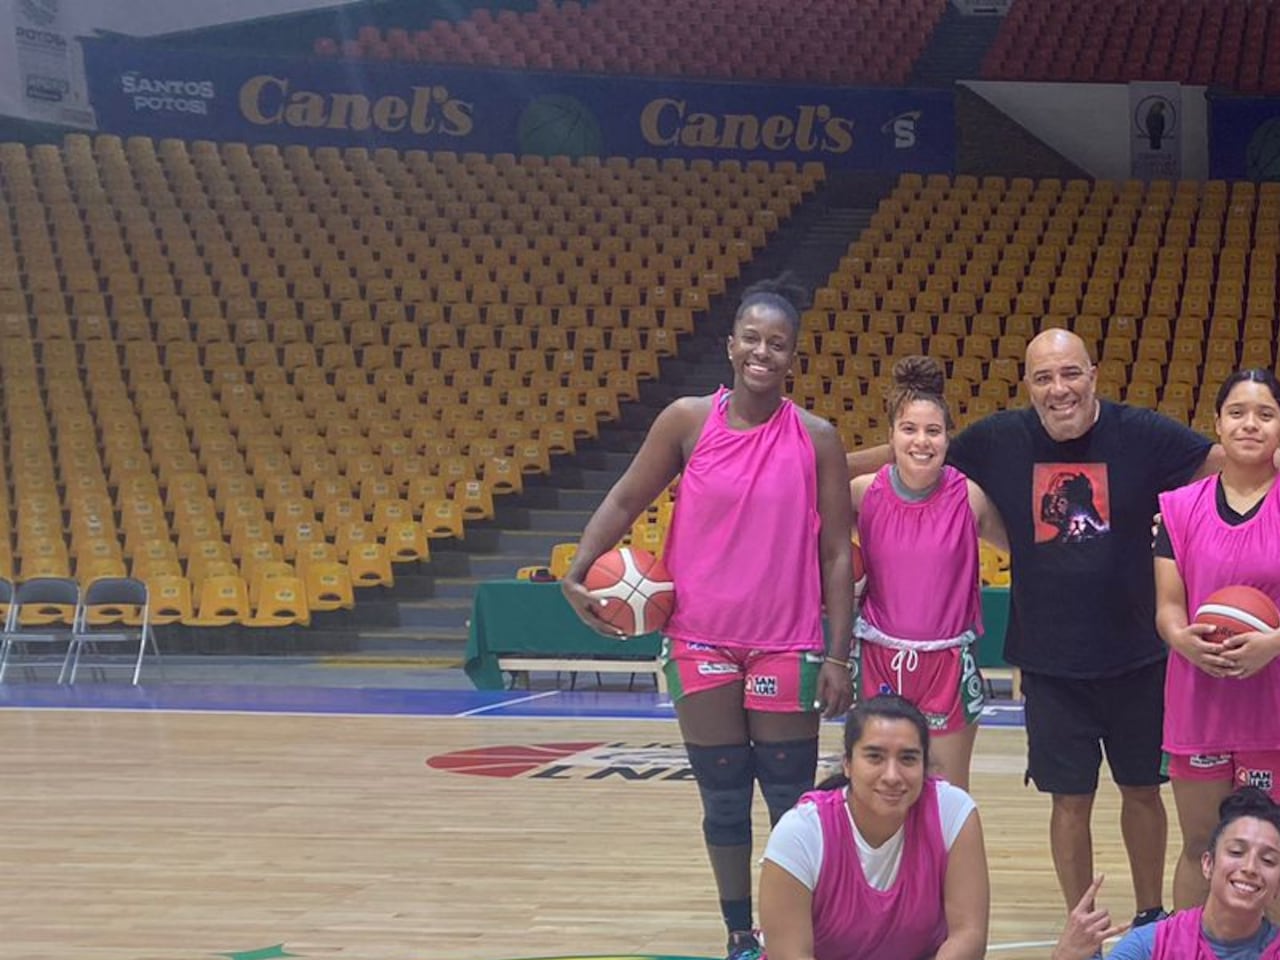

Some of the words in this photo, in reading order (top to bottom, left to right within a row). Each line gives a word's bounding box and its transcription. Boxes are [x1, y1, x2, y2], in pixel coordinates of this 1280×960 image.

[121, 74, 214, 99] SANTOS
[239, 75, 474, 137] Canel's
[640, 98, 855, 153] Canel's
